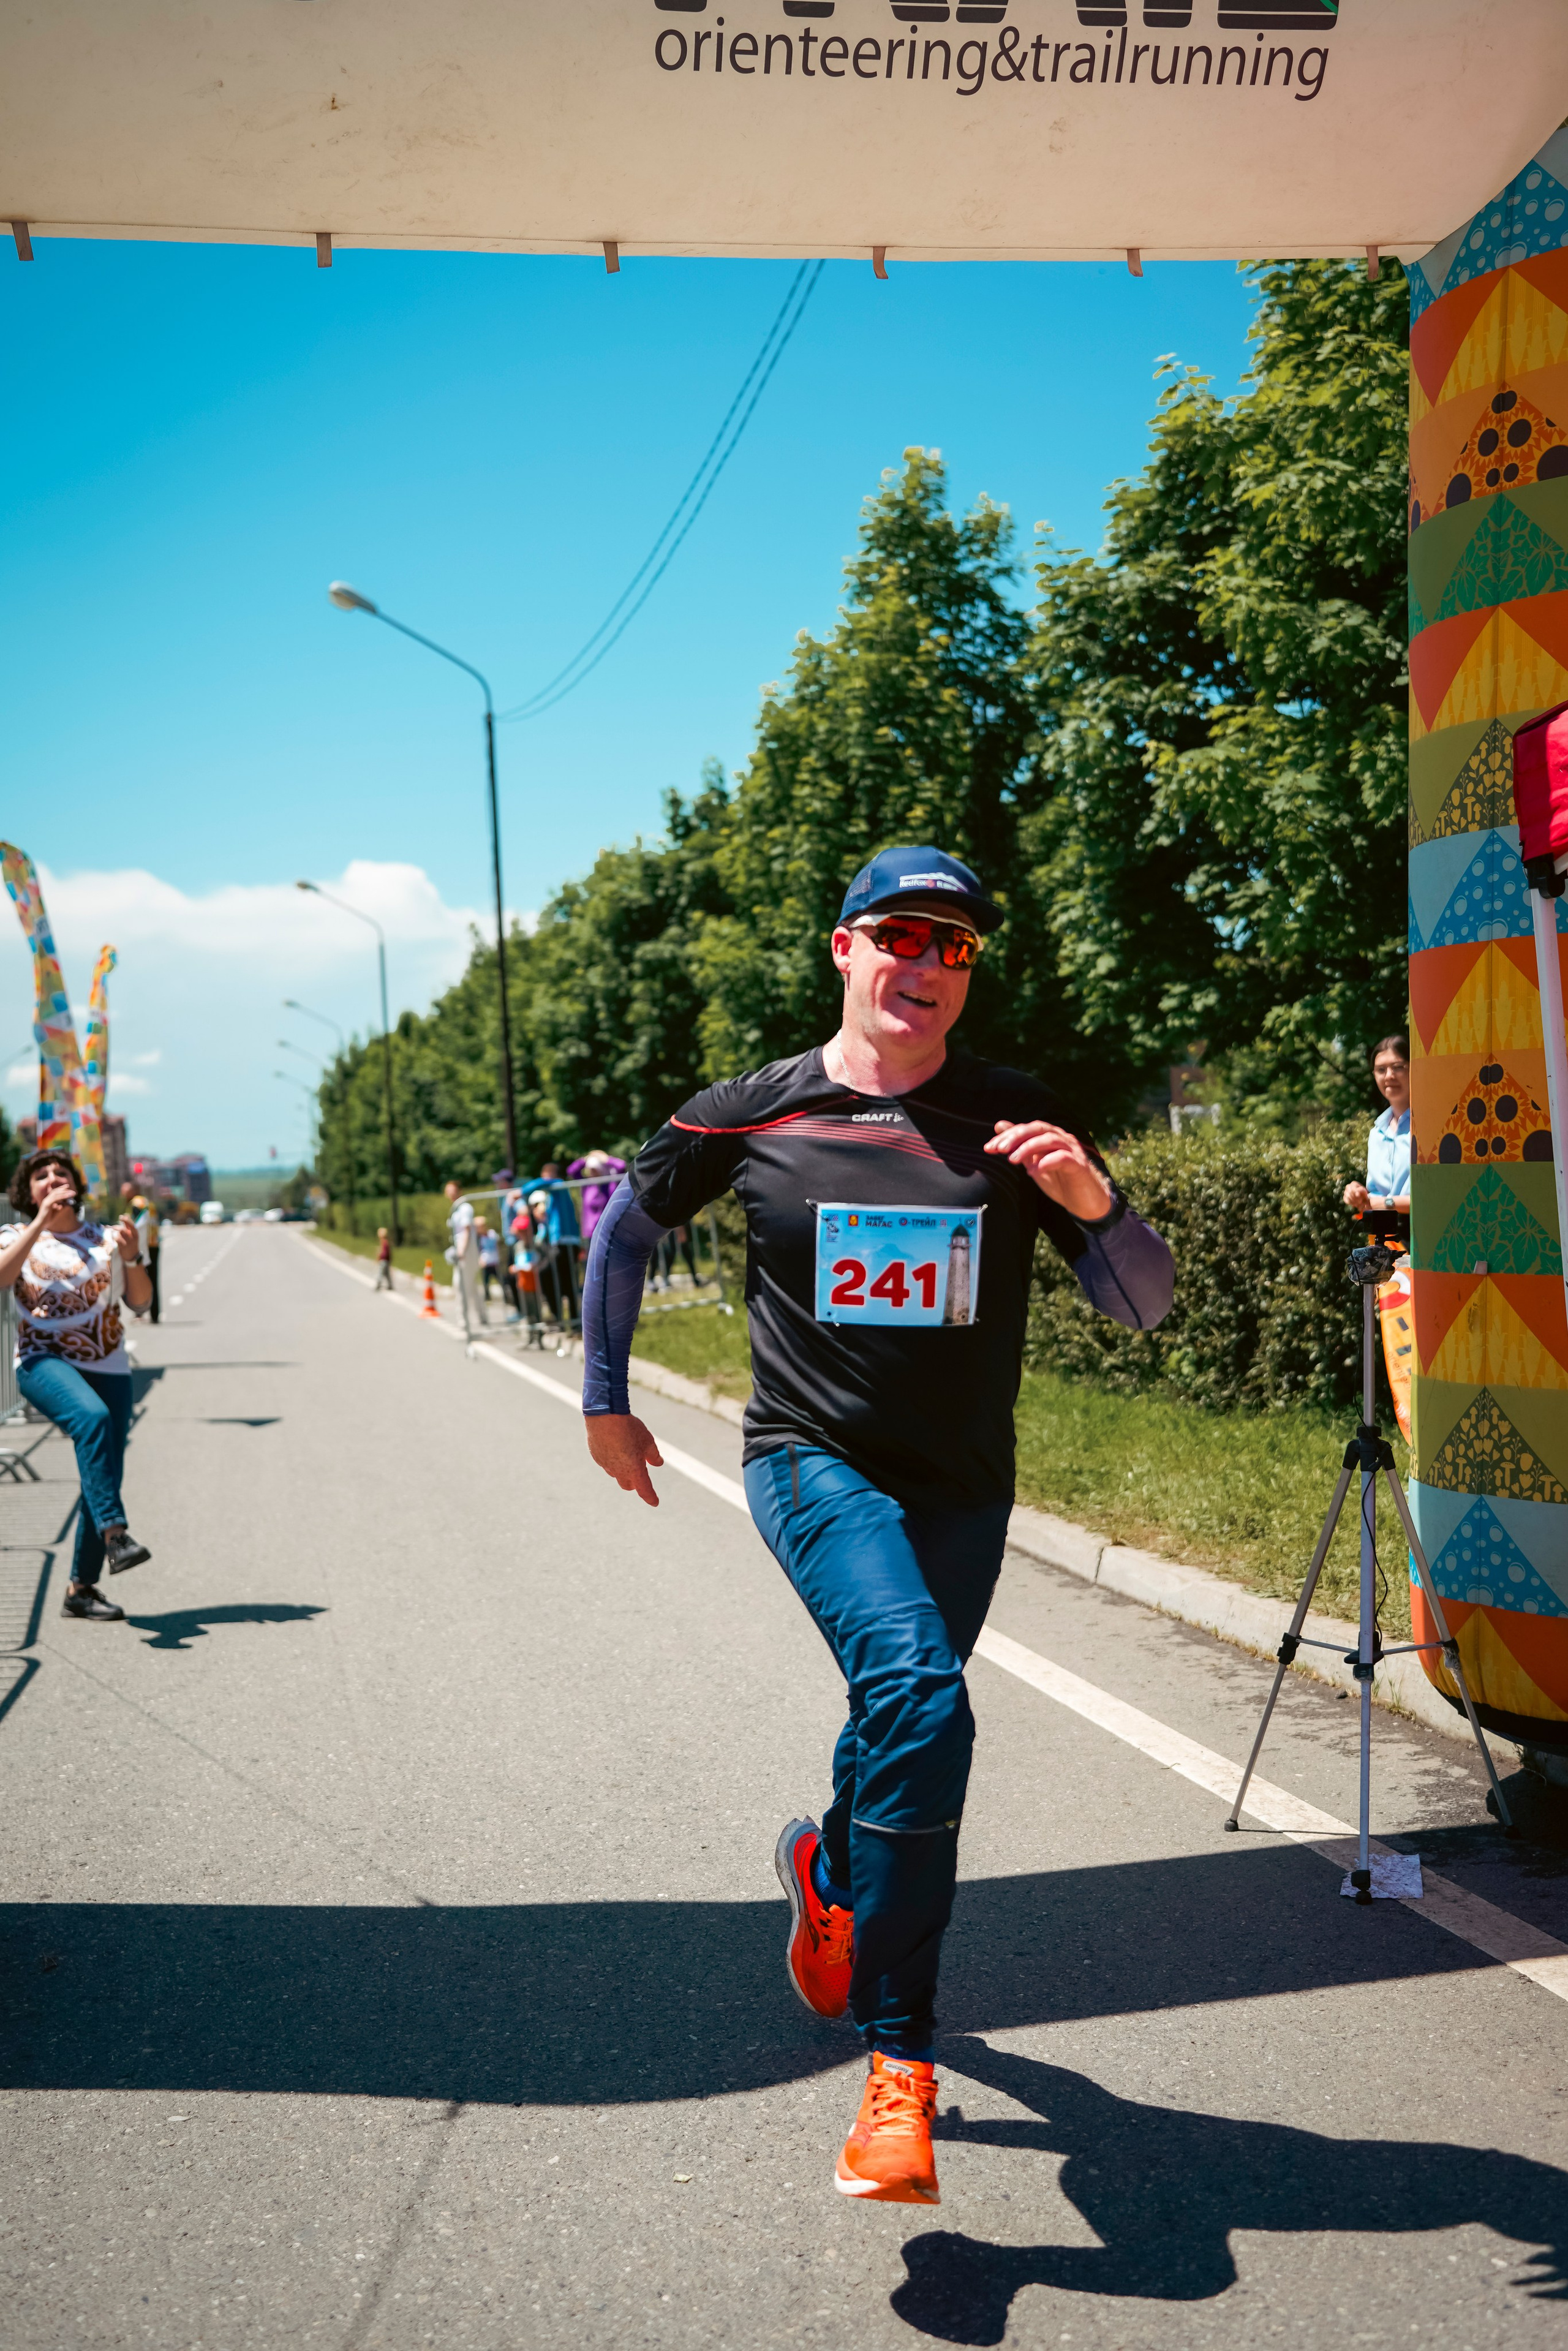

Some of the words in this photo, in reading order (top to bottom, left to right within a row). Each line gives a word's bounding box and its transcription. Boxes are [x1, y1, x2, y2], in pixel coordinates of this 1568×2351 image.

[654, 17, 1330, 101] orienteering&trailrunning
[851, 1113, 893, 1122] CRAFT
[831, 1259, 937, 1308] 241
[886, 2062, 909, 2074] saucony
